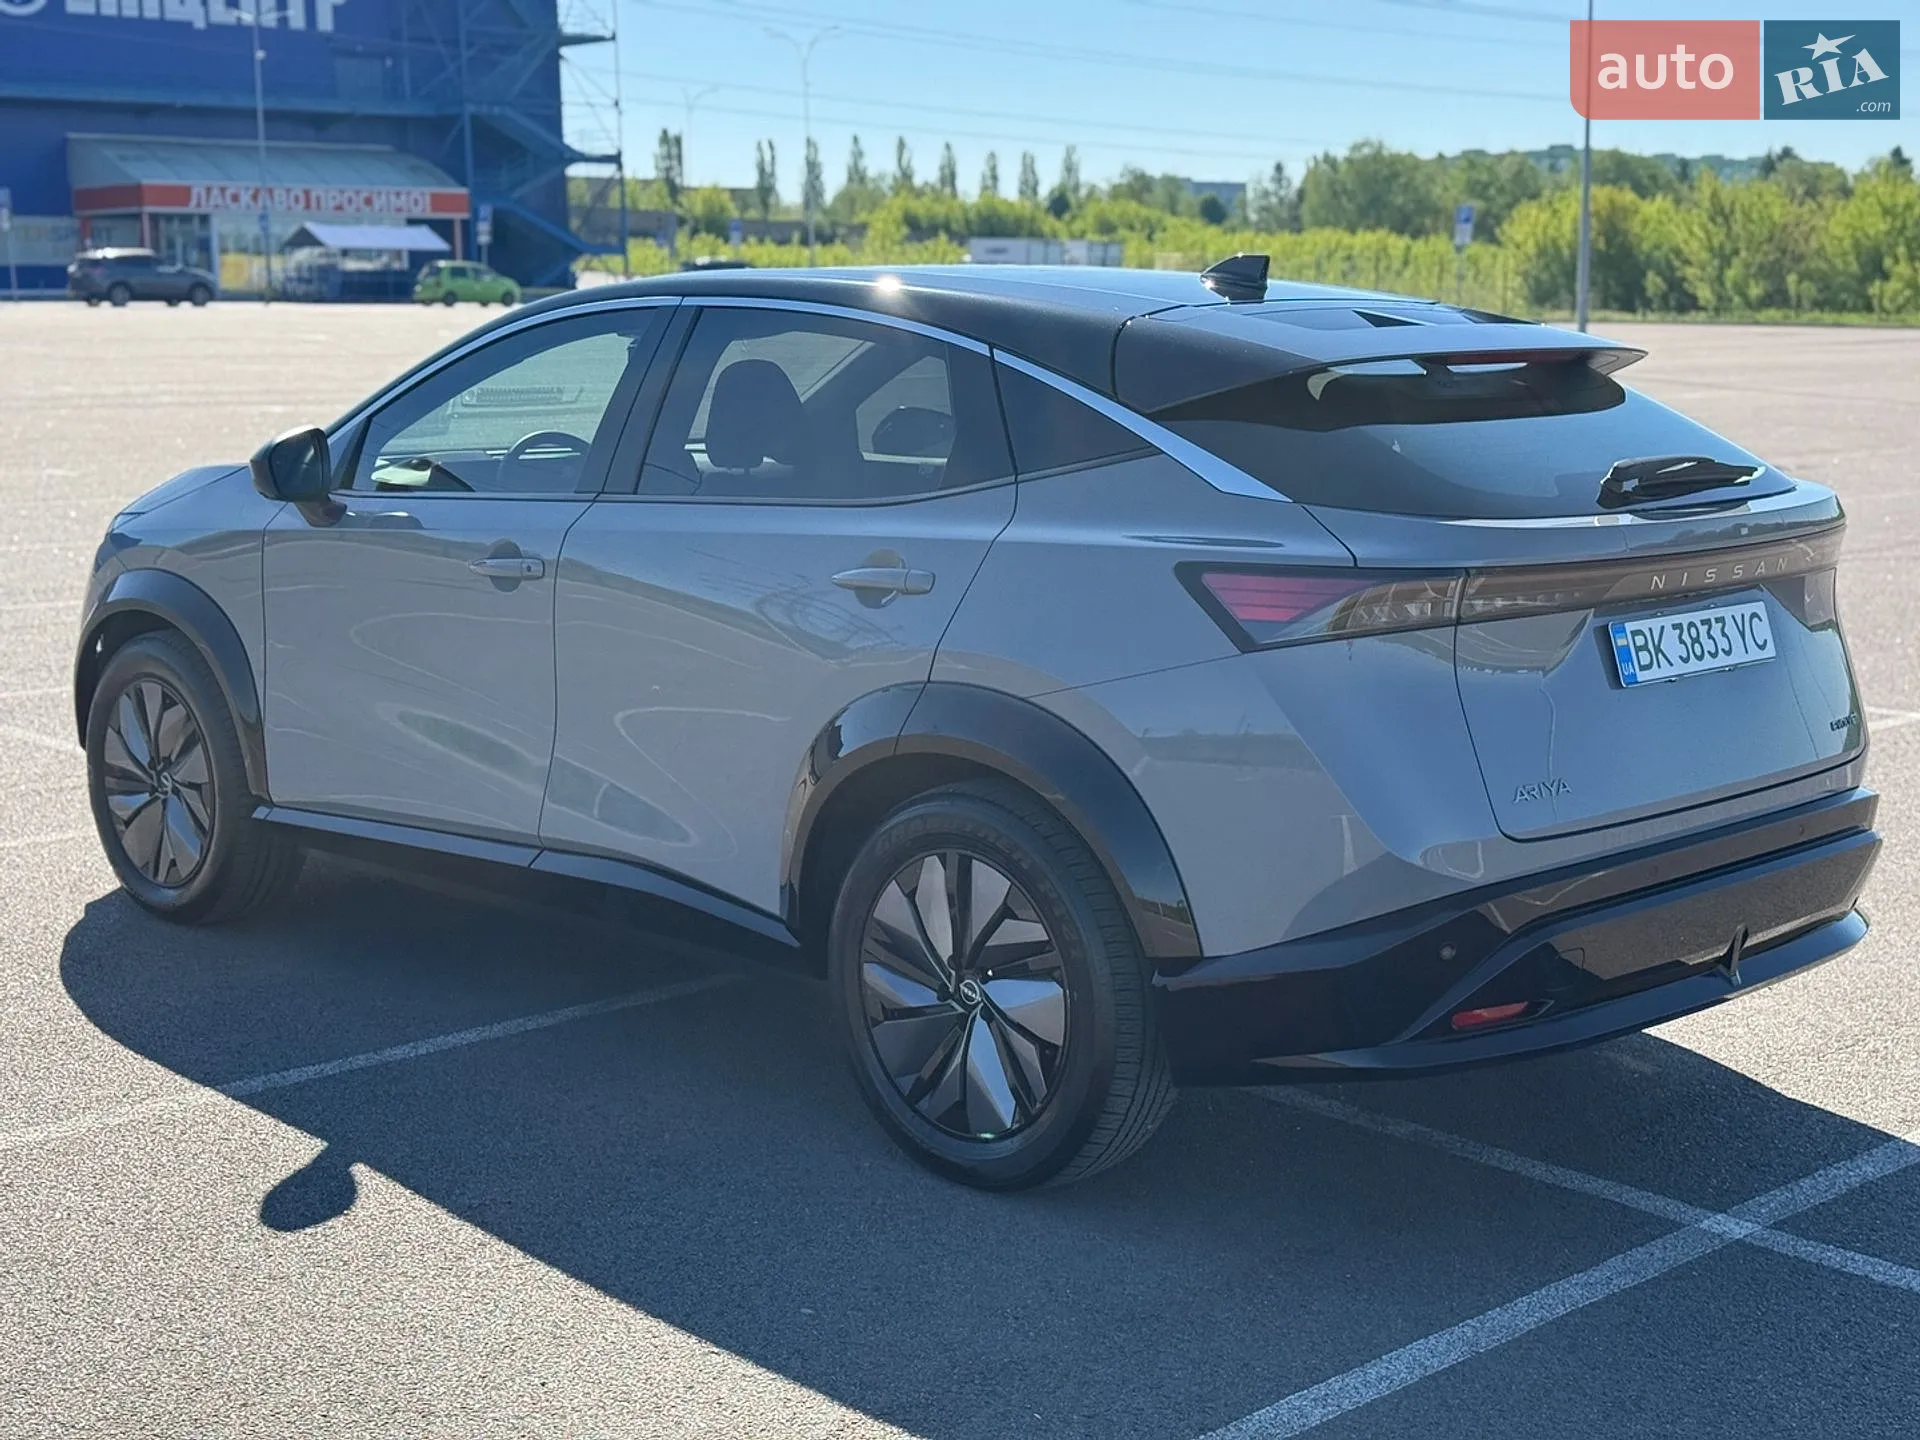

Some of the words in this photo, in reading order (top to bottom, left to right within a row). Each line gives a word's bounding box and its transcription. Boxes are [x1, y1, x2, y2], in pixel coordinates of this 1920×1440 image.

[189, 185, 303, 212] ЛАСКАВО
[309, 188, 431, 214] ПРОСИМО!
[1650, 557, 1789, 591] NISSAN
[1629, 625, 1674, 672] BK
[1671, 616, 1733, 664] 3833
[1731, 611, 1768, 655] YC
[1512, 777, 1573, 804] ARIYA
